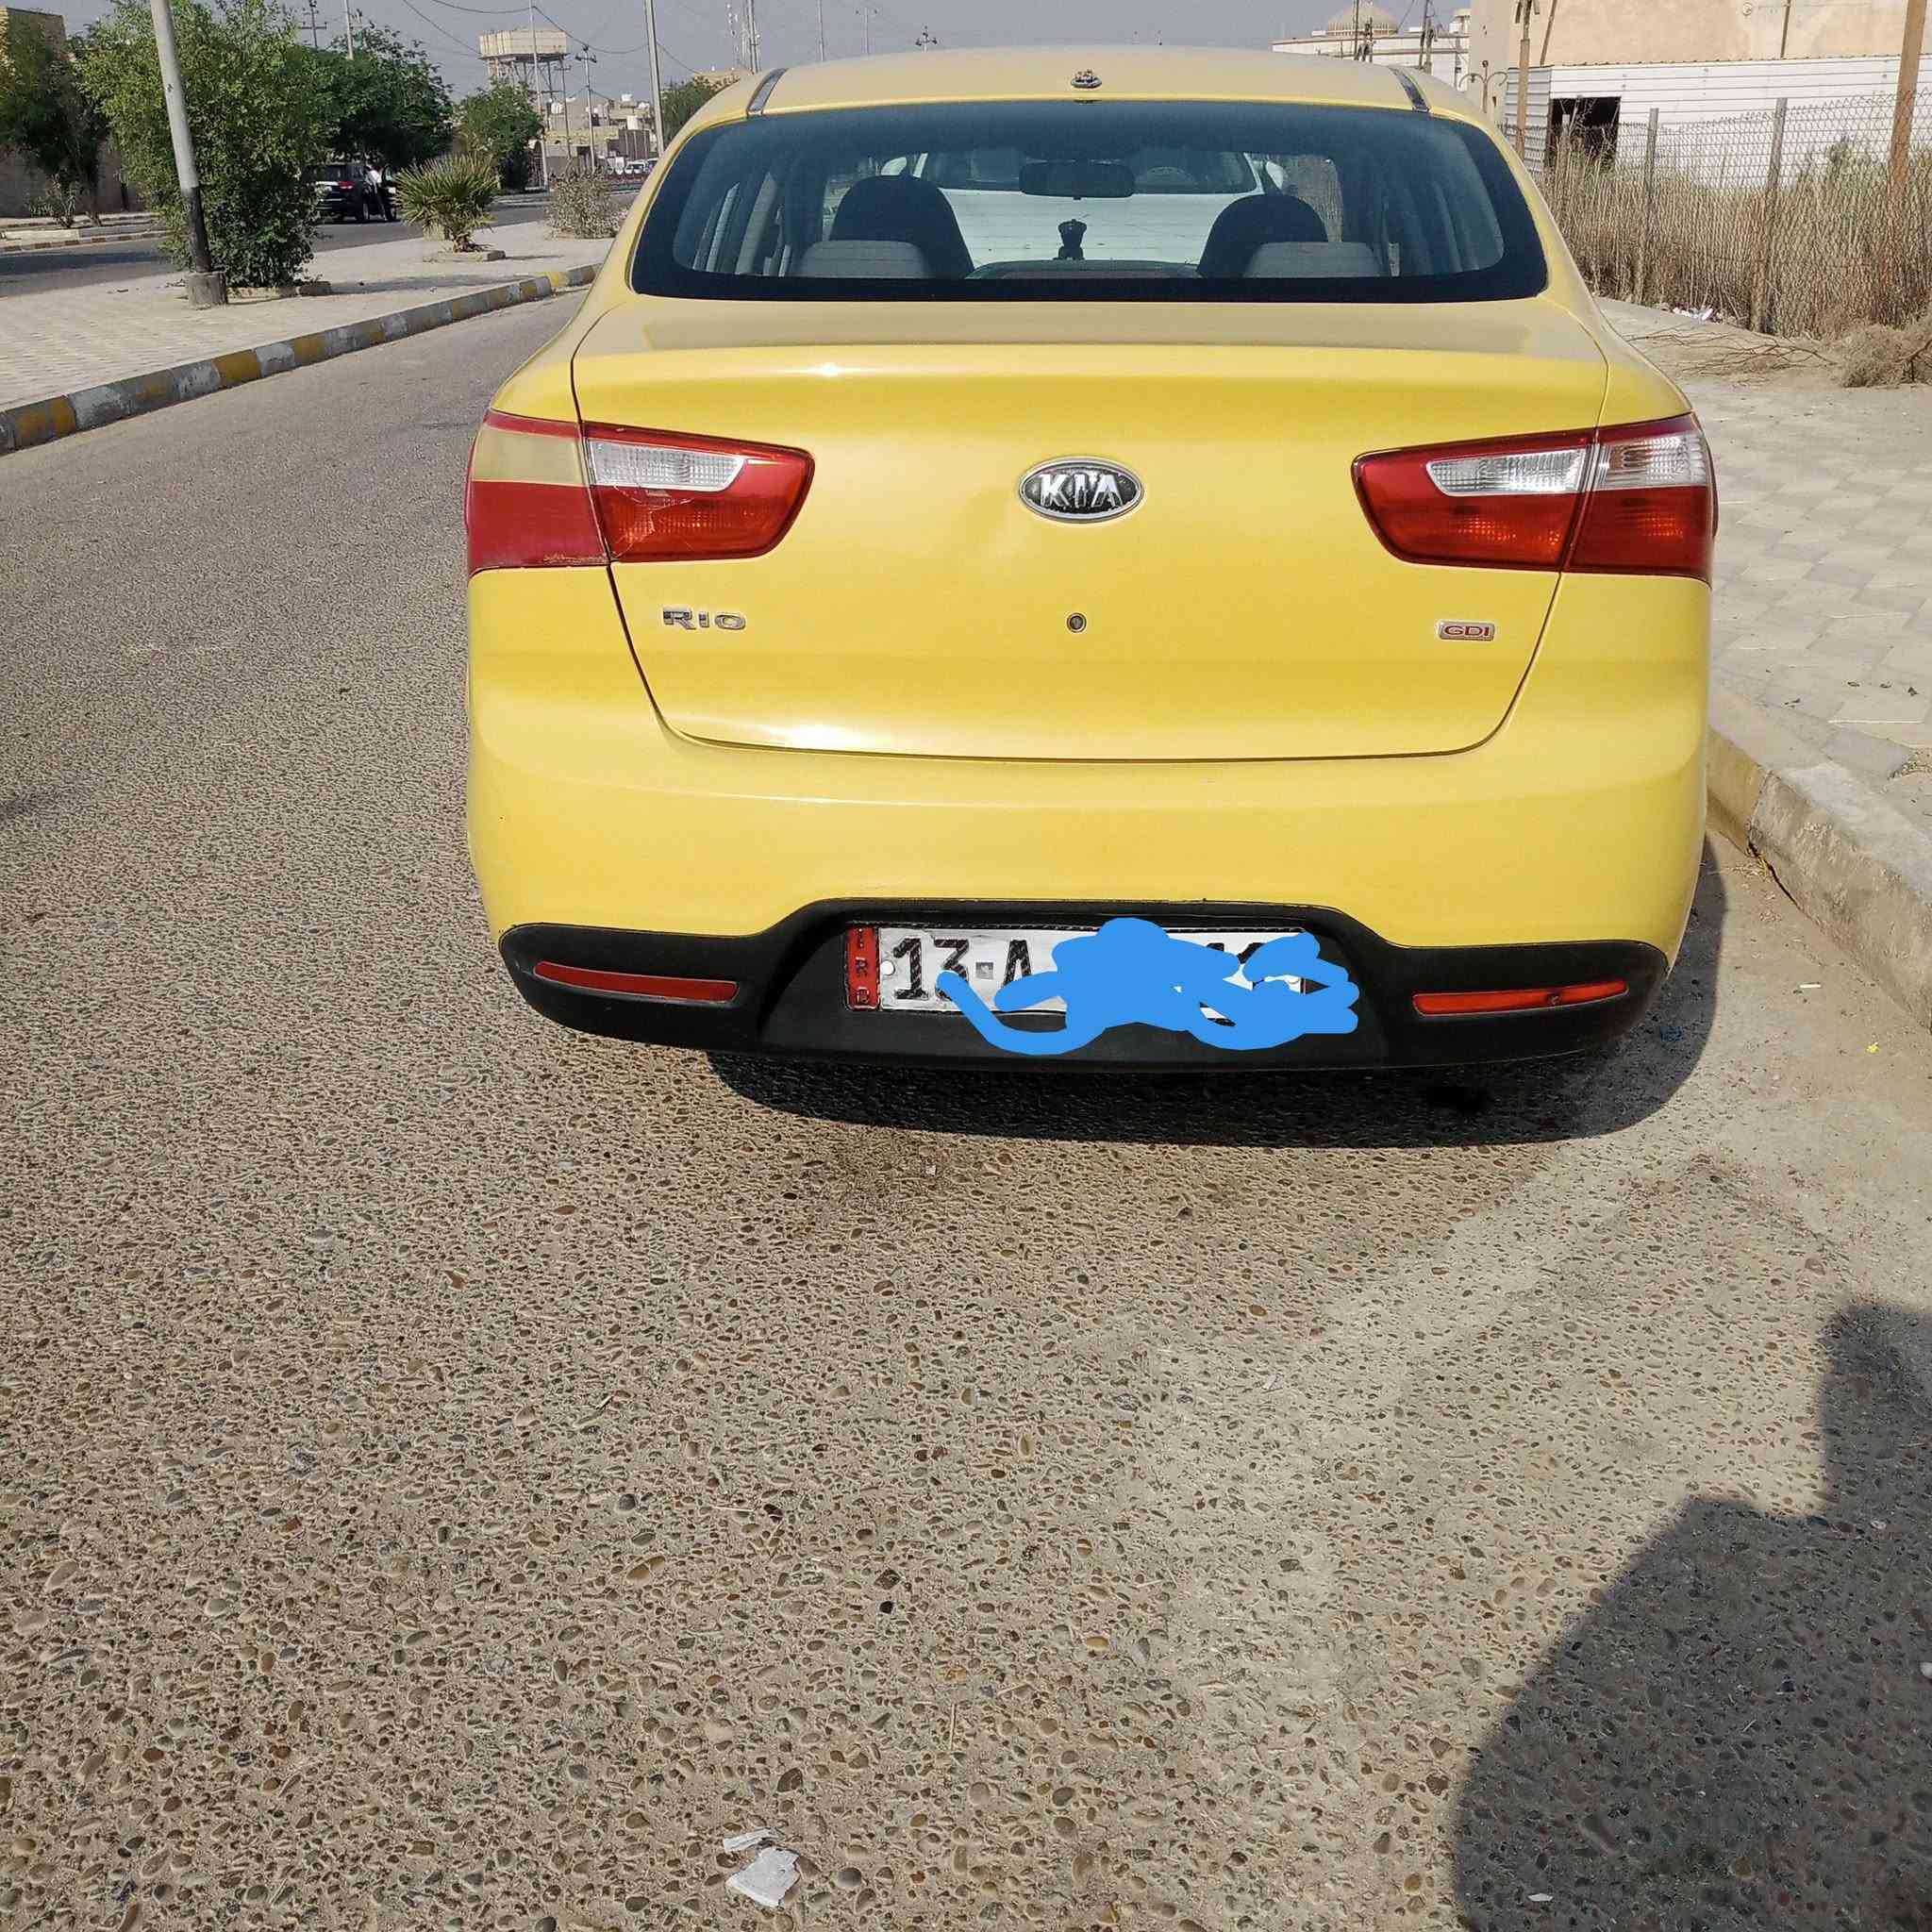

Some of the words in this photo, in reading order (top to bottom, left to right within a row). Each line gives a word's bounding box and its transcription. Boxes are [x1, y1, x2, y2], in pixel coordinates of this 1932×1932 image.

[1039, 473, 1123, 508] KIA
[662, 607, 746, 631] RIO
[1443, 625, 1491, 637] GDI
